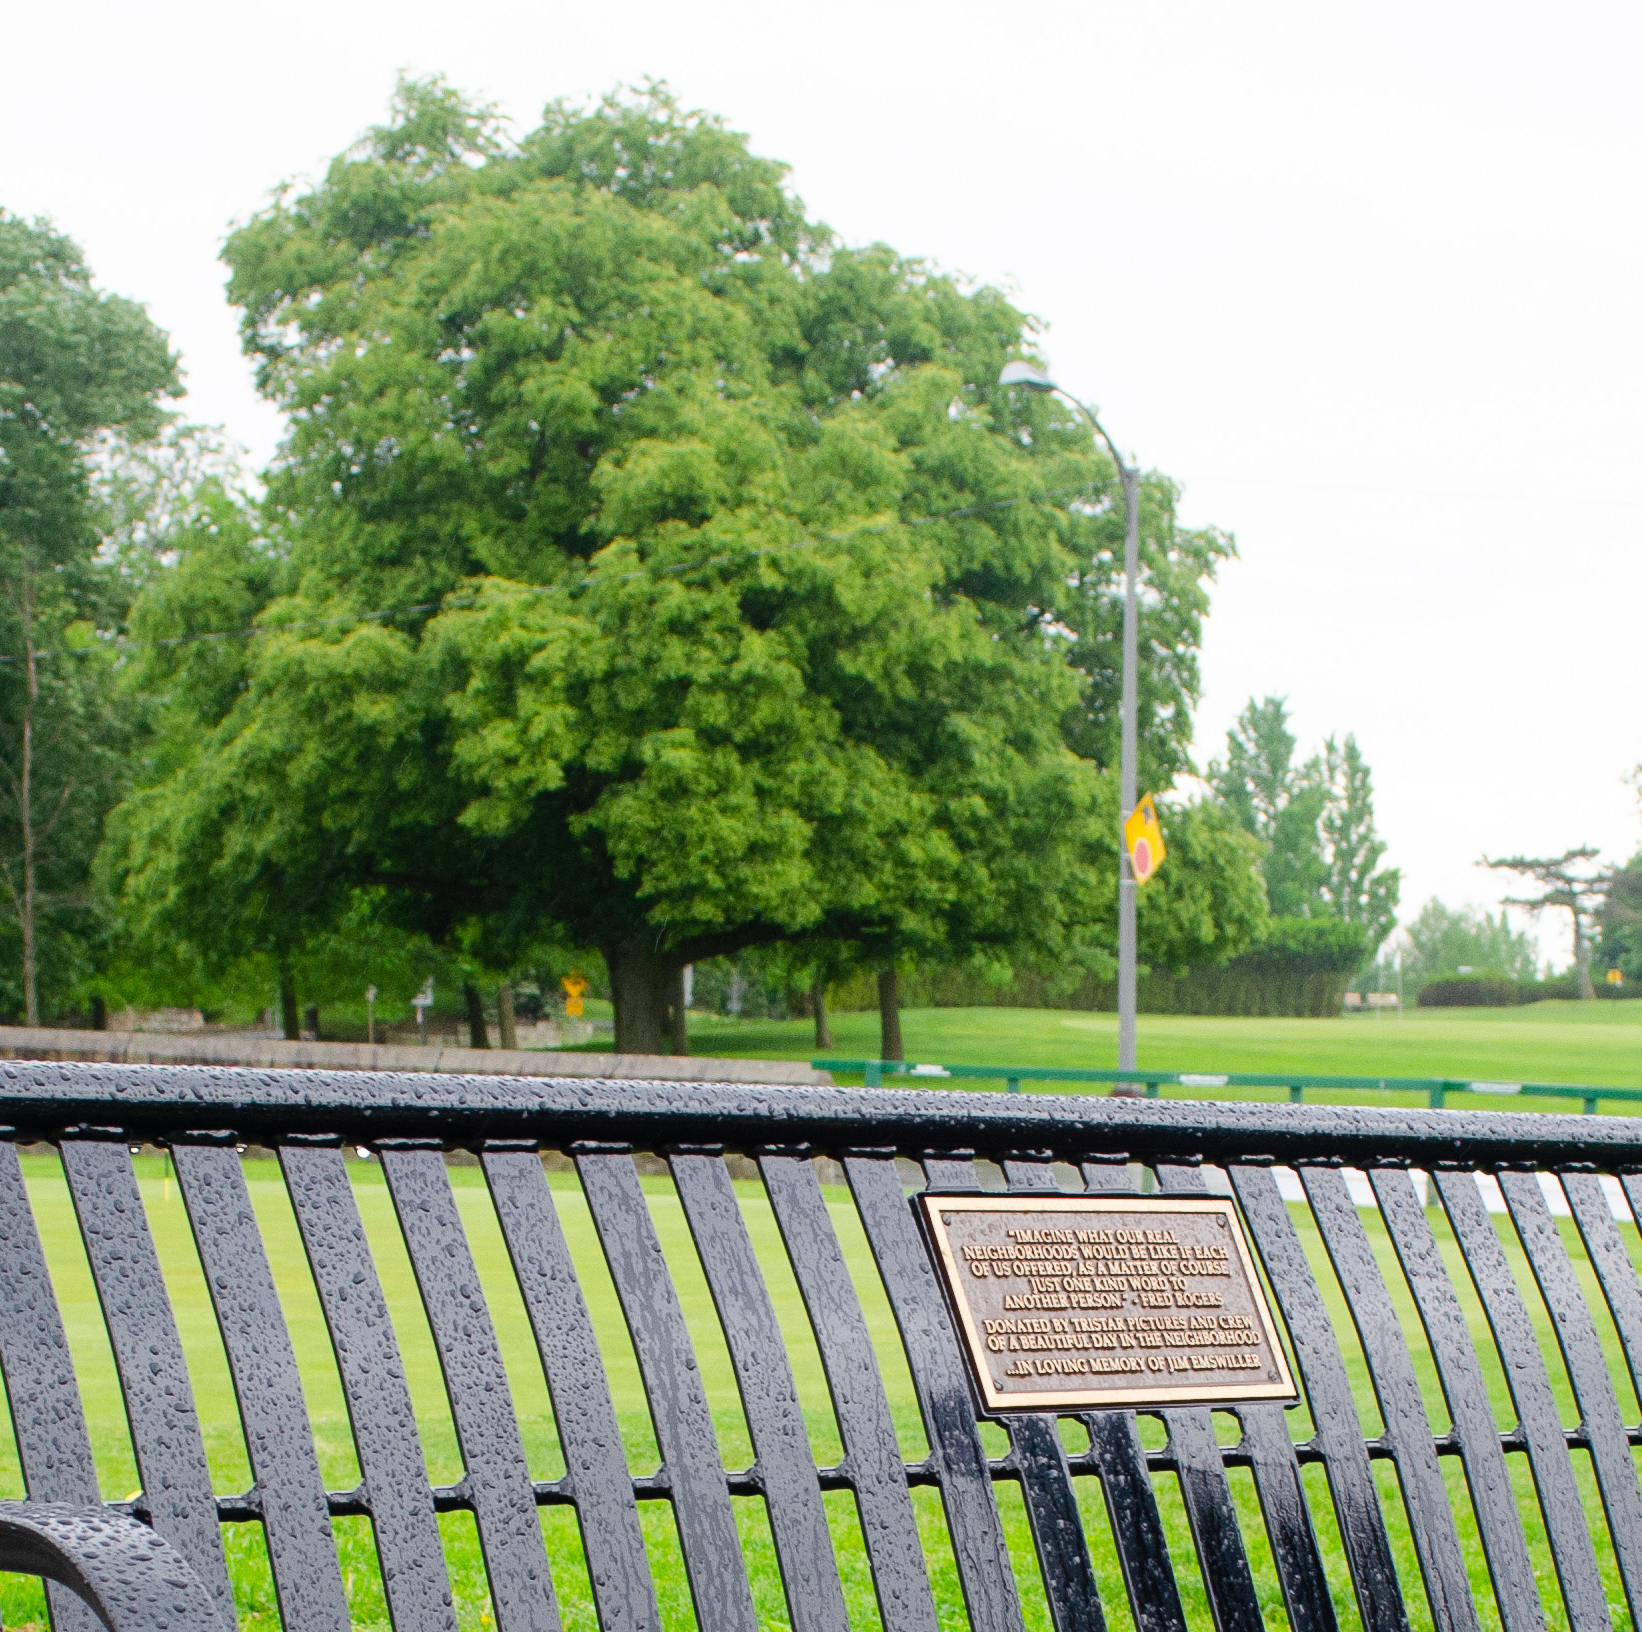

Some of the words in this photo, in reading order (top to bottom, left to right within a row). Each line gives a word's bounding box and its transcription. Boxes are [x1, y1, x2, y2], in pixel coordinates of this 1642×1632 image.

[1008, 1229, 1074, 1244] "IMAGINE
[1075, 1229, 1114, 1244] WHAT
[1116, 1229, 1147, 1243] OUR
[1147, 1229, 1180, 1243] REAL
[962, 1245, 1080, 1260] NEIGHBORHOODS
[1080, 1245, 1128, 1259] WOULD
[1129, 1245, 1148, 1259] BE
[1148, 1245, 1179, 1259] LIKE
[1180, 1246, 1193, 1259] IF
[1193, 1245, 1229, 1259] EACH
[971, 1261, 990, 1276] OF
[992, 1261, 1012, 1276] US
[1078, 1261, 1095, 1275] AS
[1097, 1261, 1108, 1275] A
[1109, 1261, 1159, 1275] MATTER
[1160, 1261, 1179, 1275] OF
[1180, 1261, 1230, 1276] COURSE
[1030, 1277, 1060, 1293] JUST
[1063, 1277, 1093, 1291] ONE
[1093, 1277, 1128, 1291] KIND
[1128, 1276, 1169, 1291] WORD
[1170, 1277, 1188, 1291] TO
[1005, 1294, 1069, 1309] ANOTHER
[1140, 1293, 1173, 1307] FRED
[1174, 1292, 1223, 1307] ROGERS
[984, 1319, 1051, 1333] DONATED
[1052, 1318, 1069, 1332] BY
[1071, 1317, 1126, 1332] TRISTAR
[1126, 1316, 1187, 1331] PICTURES
[1189, 1316, 1217, 1329] AND
[1218, 1315, 1253, 1329] CREW
[987, 1335, 1006, 1350] OF
[1008, 1335, 1020, 1350] A
[1020, 1334, 1092, 1350] BEAUTIFUL
[1092, 1333, 1119, 1348] DAY
[1119, 1332, 1136, 1347] IN
[1136, 1332, 1163, 1347] THE
[1163, 1331, 1262, 1346] NEIGHBORHOOD
[1035, 1359, 1088, 1374] LOVING
[1089, 1357, 1146, 1373] MEMORY
[1148, 1356, 1166, 1371] OF
[1166, 1355, 1190, 1373] JIM
[1190, 1354, 1262, 1369] EMSWILLER
